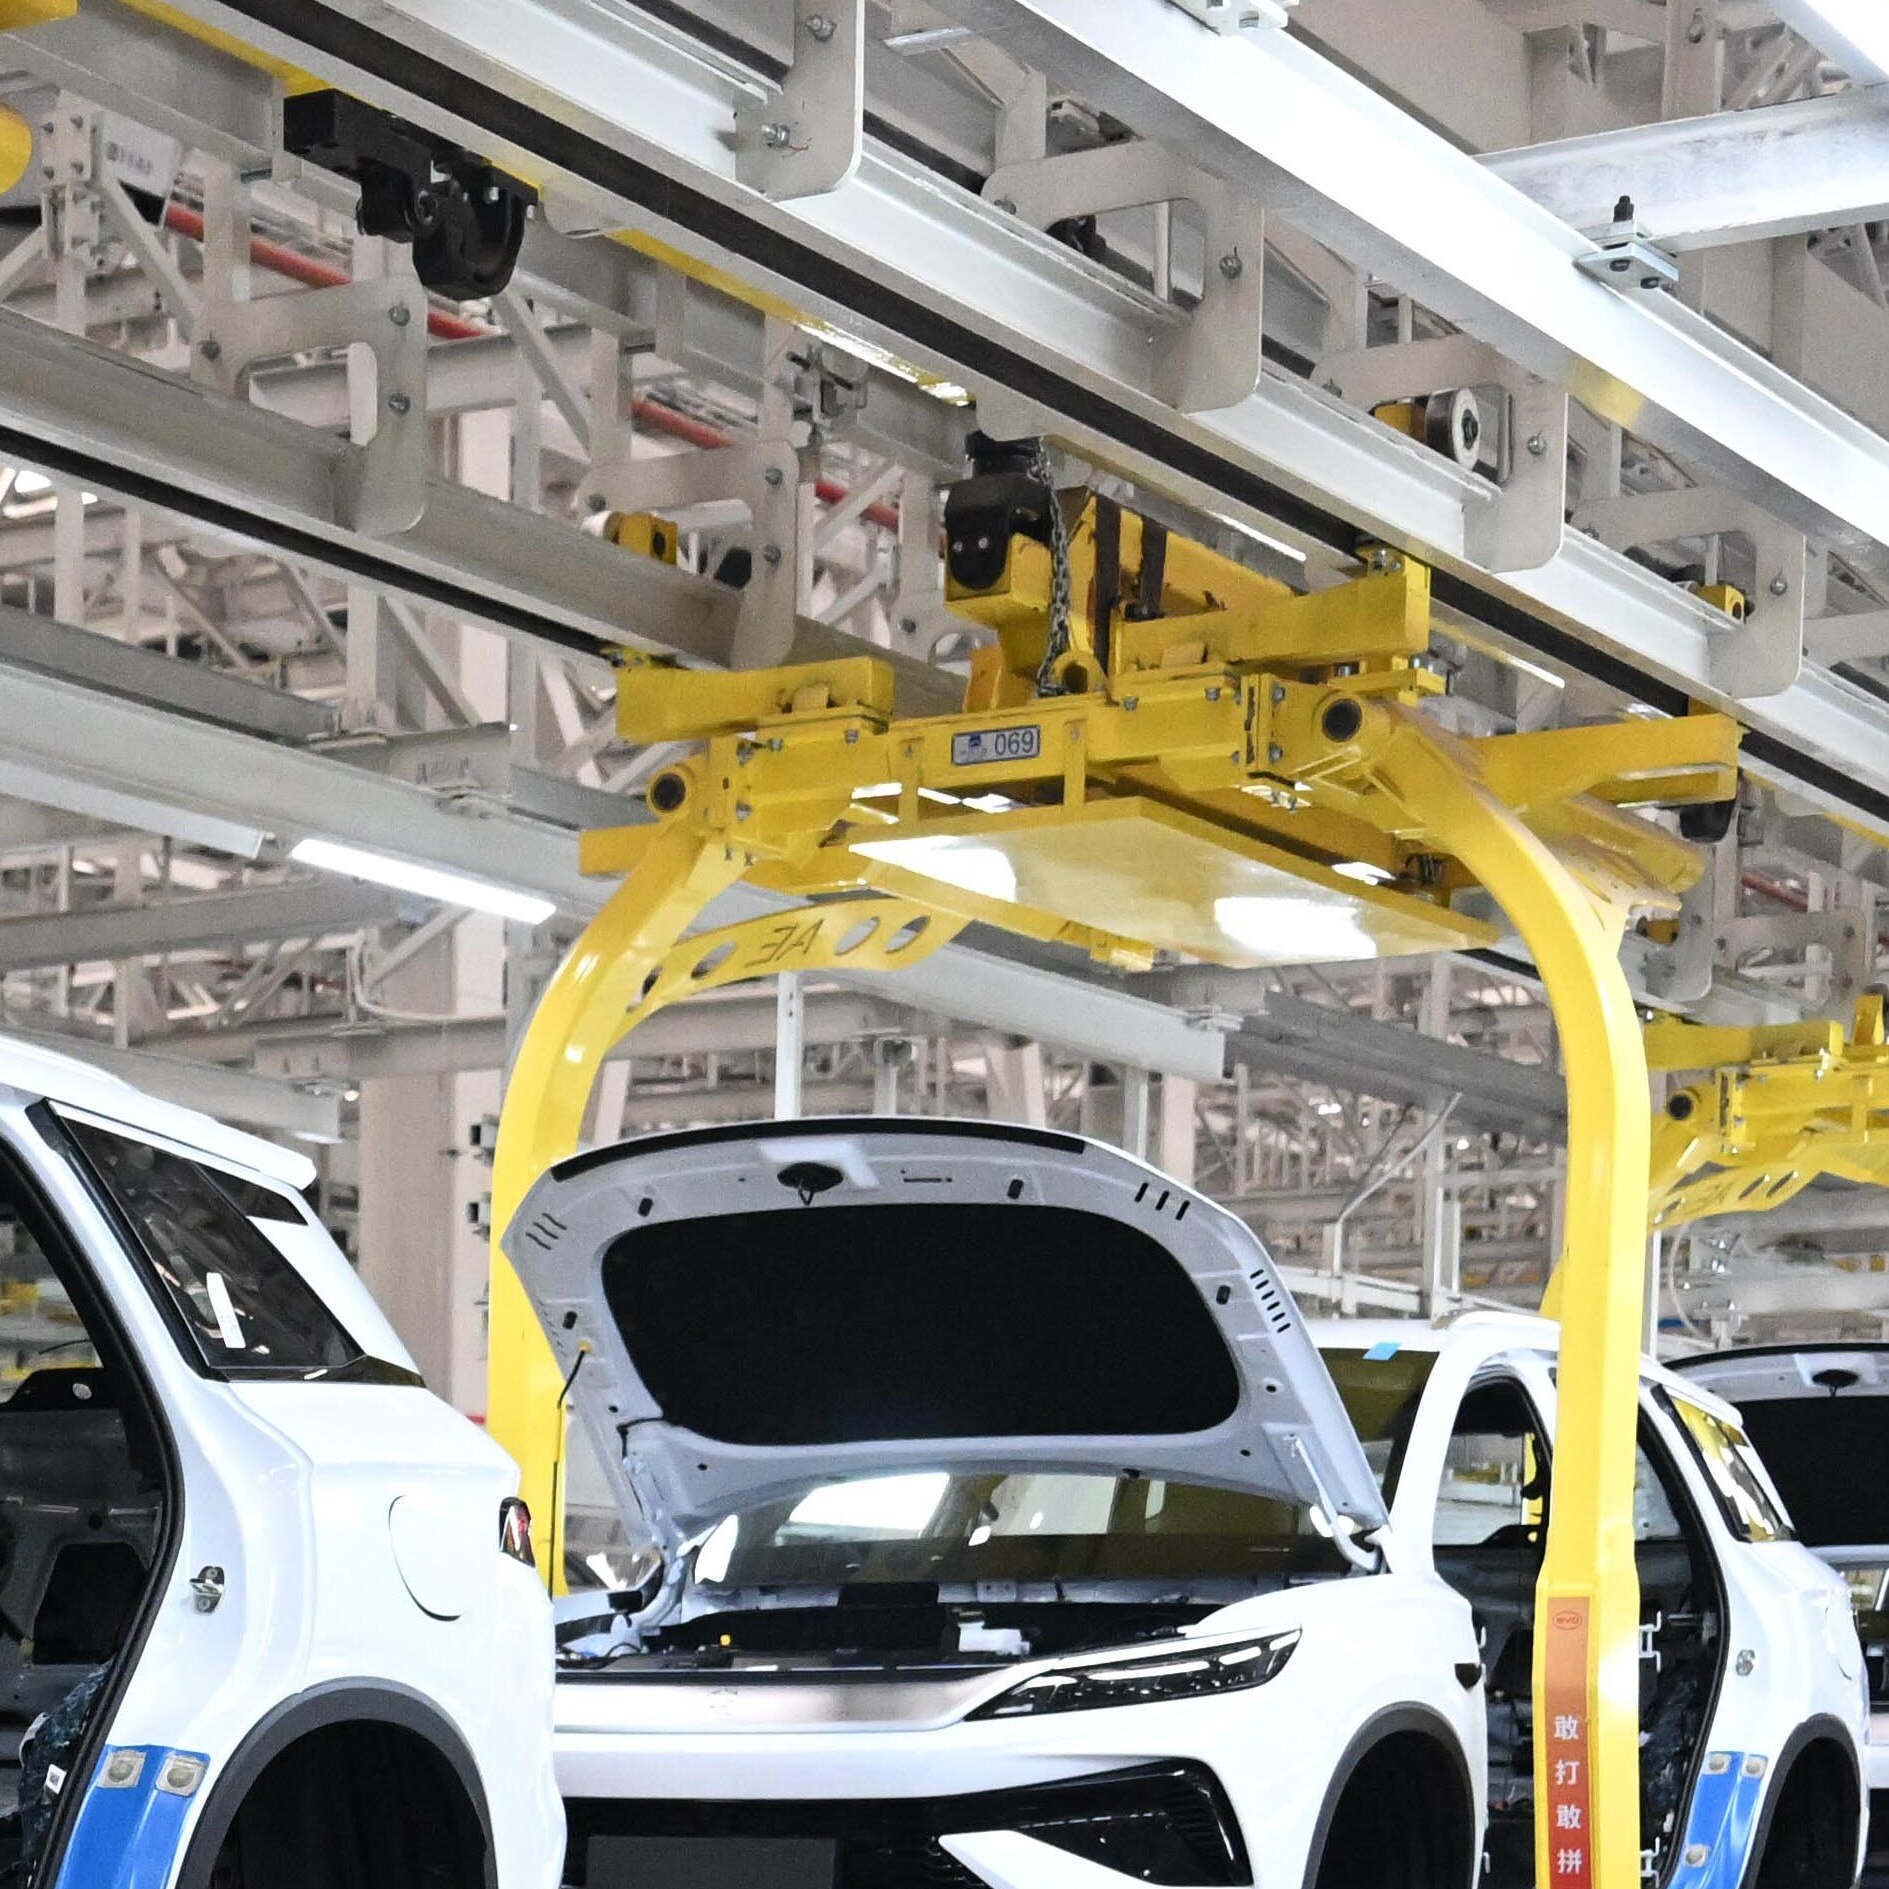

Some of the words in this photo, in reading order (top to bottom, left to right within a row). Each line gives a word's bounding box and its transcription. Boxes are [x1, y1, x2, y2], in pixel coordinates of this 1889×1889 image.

[994, 730, 1034, 756] 069
[1554, 1714, 1583, 1875] 敢打敢拼
